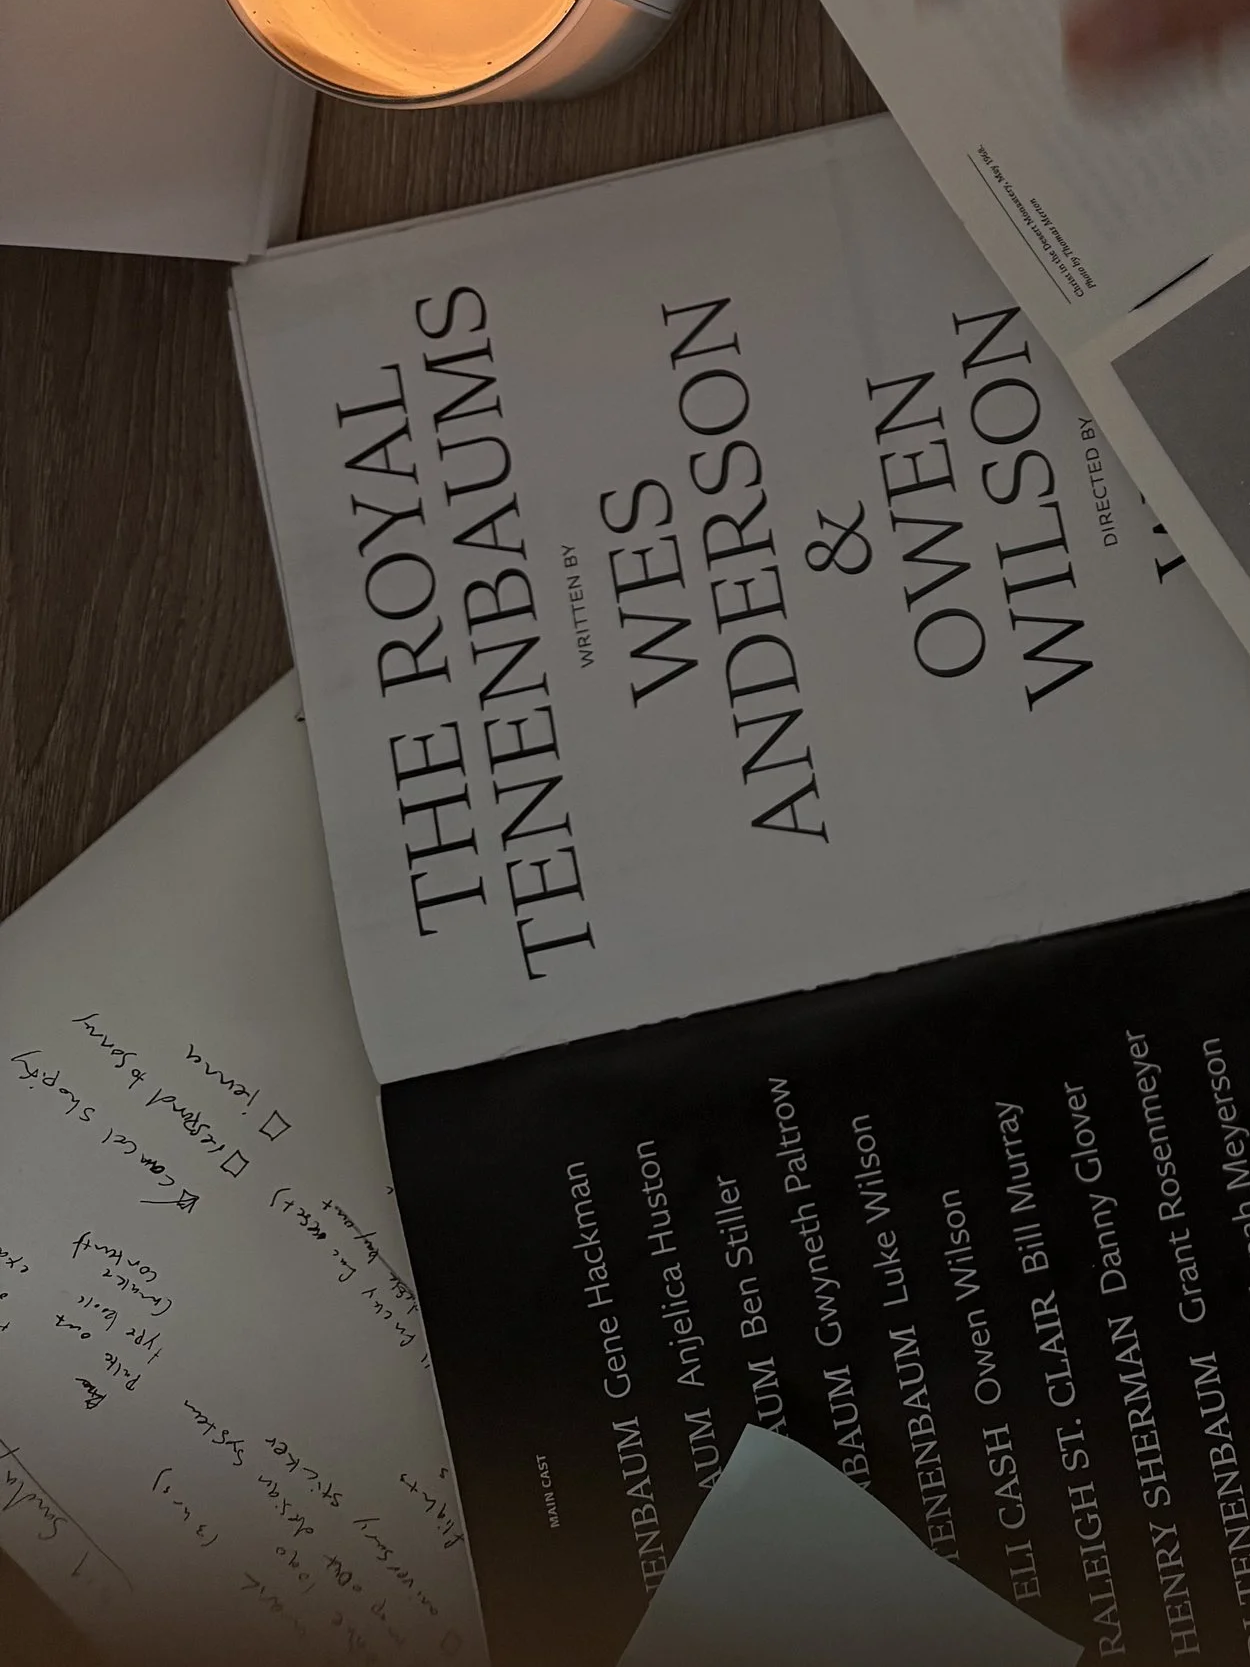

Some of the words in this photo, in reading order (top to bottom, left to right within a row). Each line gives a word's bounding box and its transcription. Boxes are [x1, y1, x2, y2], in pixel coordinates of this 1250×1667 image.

[1029, 197, 1053, 226] Merton
[1048, 226, 1073, 258] Thomas
[1070, 256, 1081, 268] by
[1077, 266, 1097, 289] Photo
[1077, 417, 1096, 441] BY
[335, 363, 452, 698] ROYAL
[804, 499, 873, 575] &
[865, 371, 984, 678] OWEN
[951, 305, 1093, 712] WILSON
[1085, 447, 1118, 547] DIRECTED
[561, 544, 578, 568] BY
[599, 478, 699, 709] WES
[660, 297, 829, 841] ANDERSON
[415, 286, 596, 981] TENENBAUMS
[566, 575, 594, 668] WRITTEN
[388, 720, 487, 937] THE
[768, 1077, 811, 1193] Paltrow
[851, 1114, 891, 1224] Wilson
[994, 1101, 1036, 1213] Murray
[1064, 1081, 1102, 1183] Glover
[1125, 1029, 1186, 1221] Rosenmeyer
[566, 1161, 613, 1308] Hackman
[636, 1140, 677, 1256] Huston
[716, 1174, 753, 1268] Stiller
[942, 1189, 980, 1302] Wilson
[1012, 1222, 1049, 1274] Bill
[1088, 1193, 1127, 1295] Danny
[738, 1276, 768, 1338] Ben
[789, 1202, 842, 1347] Gwyneth
[872, 1230, 909, 1307] Luke
[1168, 1227, 1206, 1323] Grant
[599, 1316, 631, 1398] Gene
[660, 1261, 705, 1387] Anjelica
[967, 1308, 1001, 1405] Owen
[1030, 1289, 1076, 1407] CLAIR
[1056, 1418, 1089, 1471] ST.
[1107, 1315, 1171, 1508] SHERMAN
[535, 1454, 551, 1488] CAST
[544, 1491, 560, 1528] MAIN
[982, 1422, 1026, 1529] CASH
[1005, 1539, 1040, 1600] ELI
[1067, 1480, 1124, 1652] RALEIGH
[1148, 1521, 1200, 1654] HENRY
